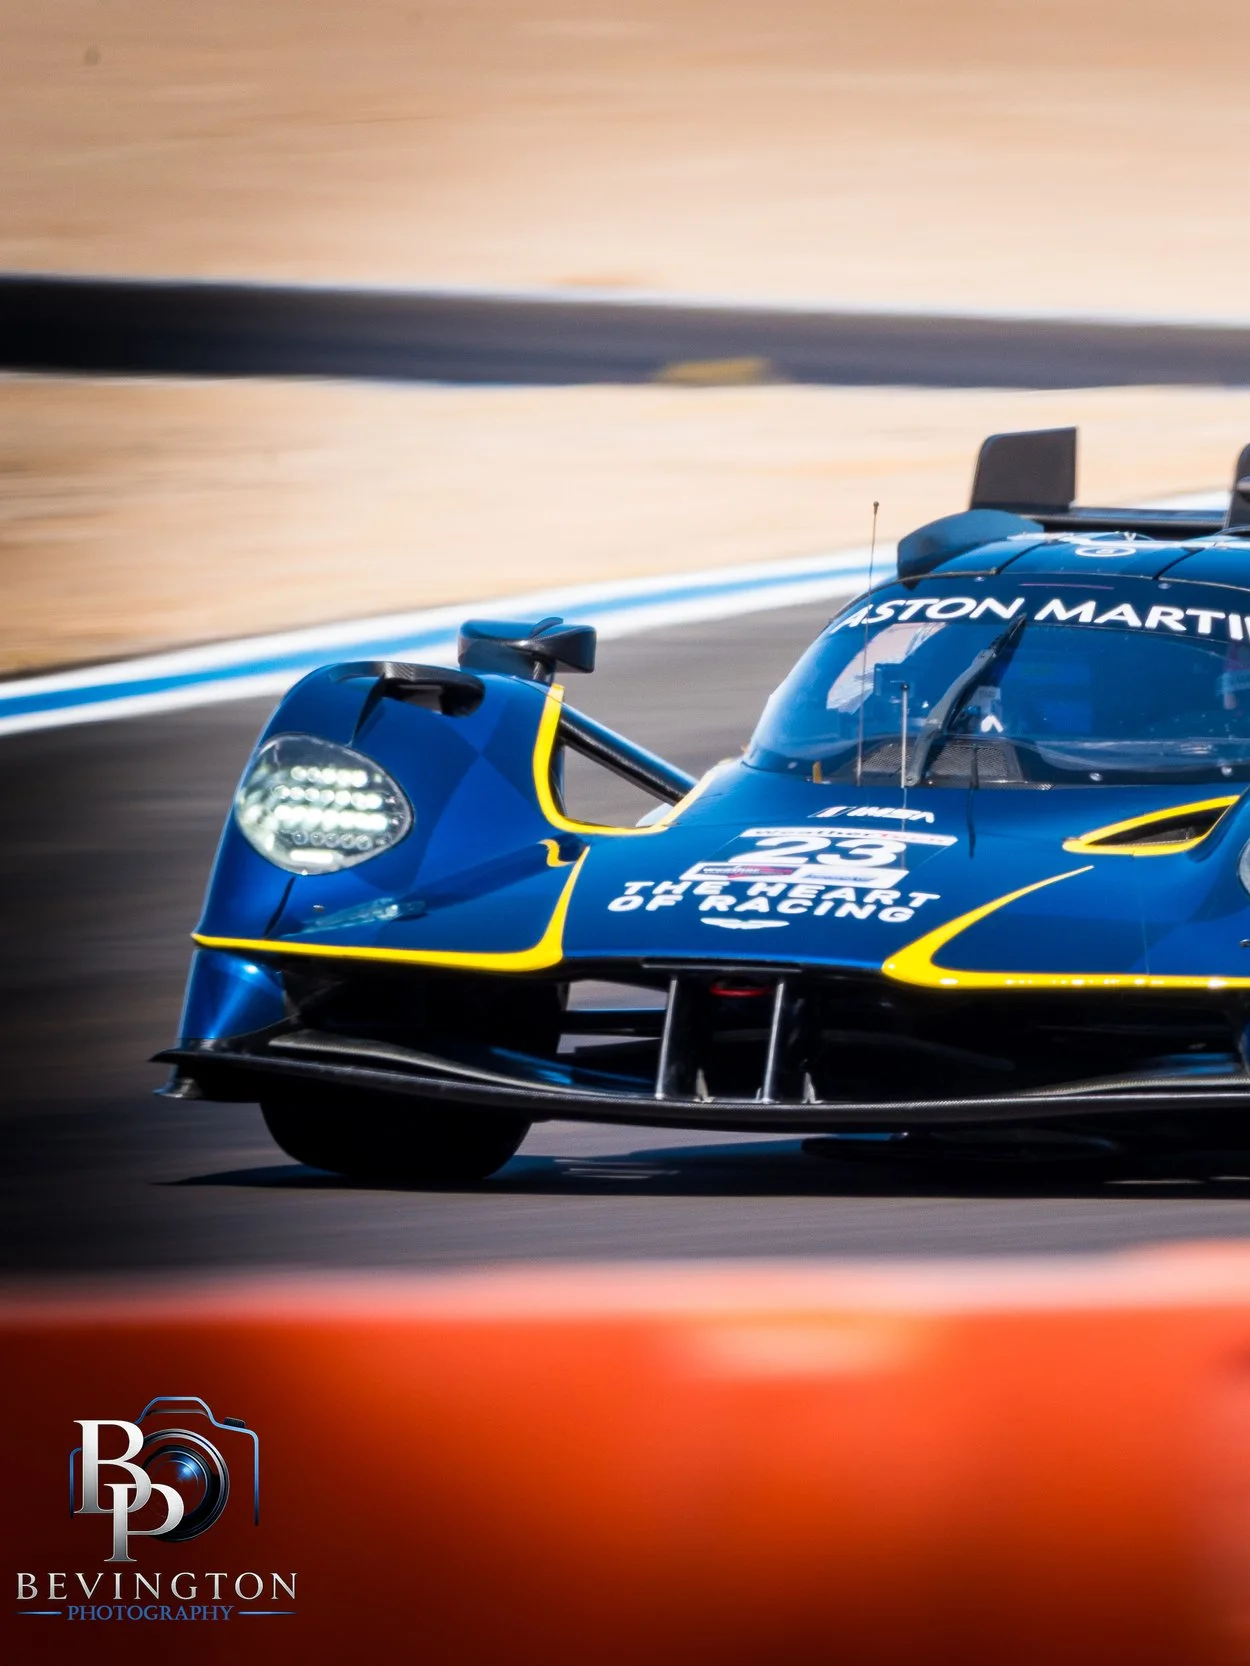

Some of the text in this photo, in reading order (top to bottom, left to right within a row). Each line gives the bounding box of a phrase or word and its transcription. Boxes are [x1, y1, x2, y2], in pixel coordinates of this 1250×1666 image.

[831, 596, 1026, 633] ASTON
[727, 835, 908, 868] 23
[607, 894, 916, 923] OF RACING
[623, 880, 942, 908] THE HEART
